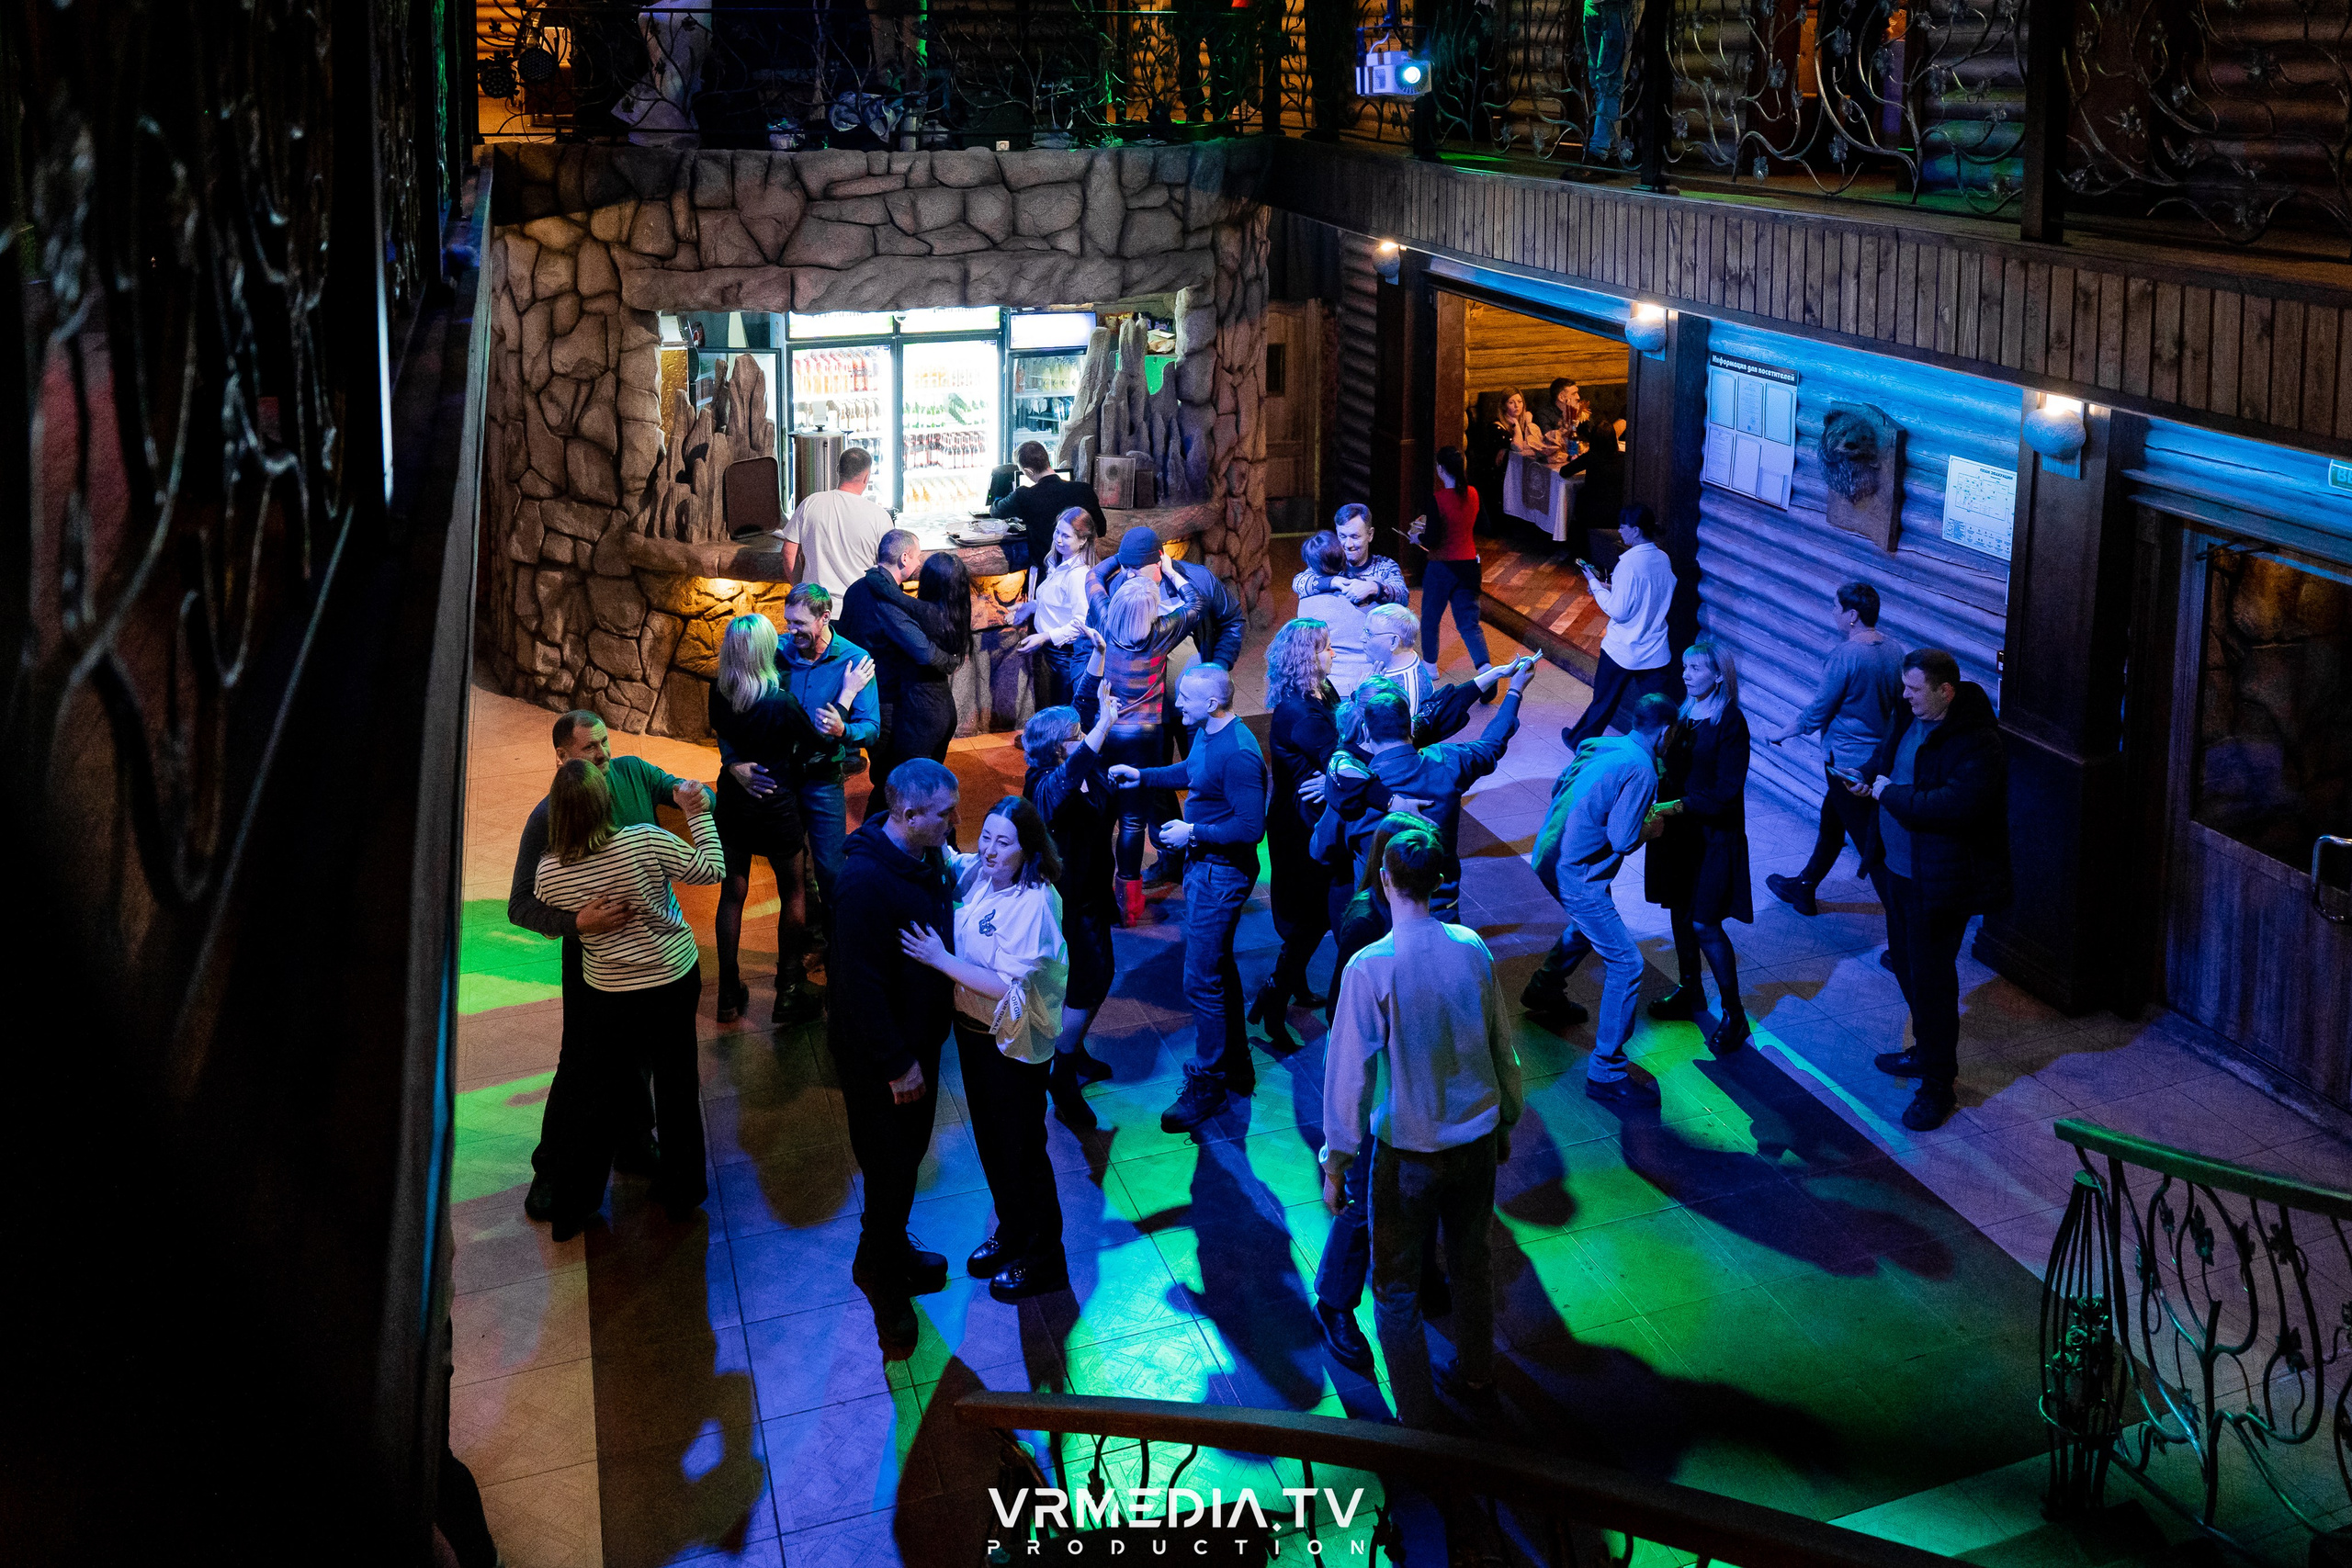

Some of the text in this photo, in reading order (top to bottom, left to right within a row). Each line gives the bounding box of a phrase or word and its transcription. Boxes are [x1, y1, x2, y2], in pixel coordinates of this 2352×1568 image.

[1712, 355, 1747, 370] Информация
[1758, 367, 1795, 382] посетителей
[993, 1000, 1009, 1030] ORGINAL
